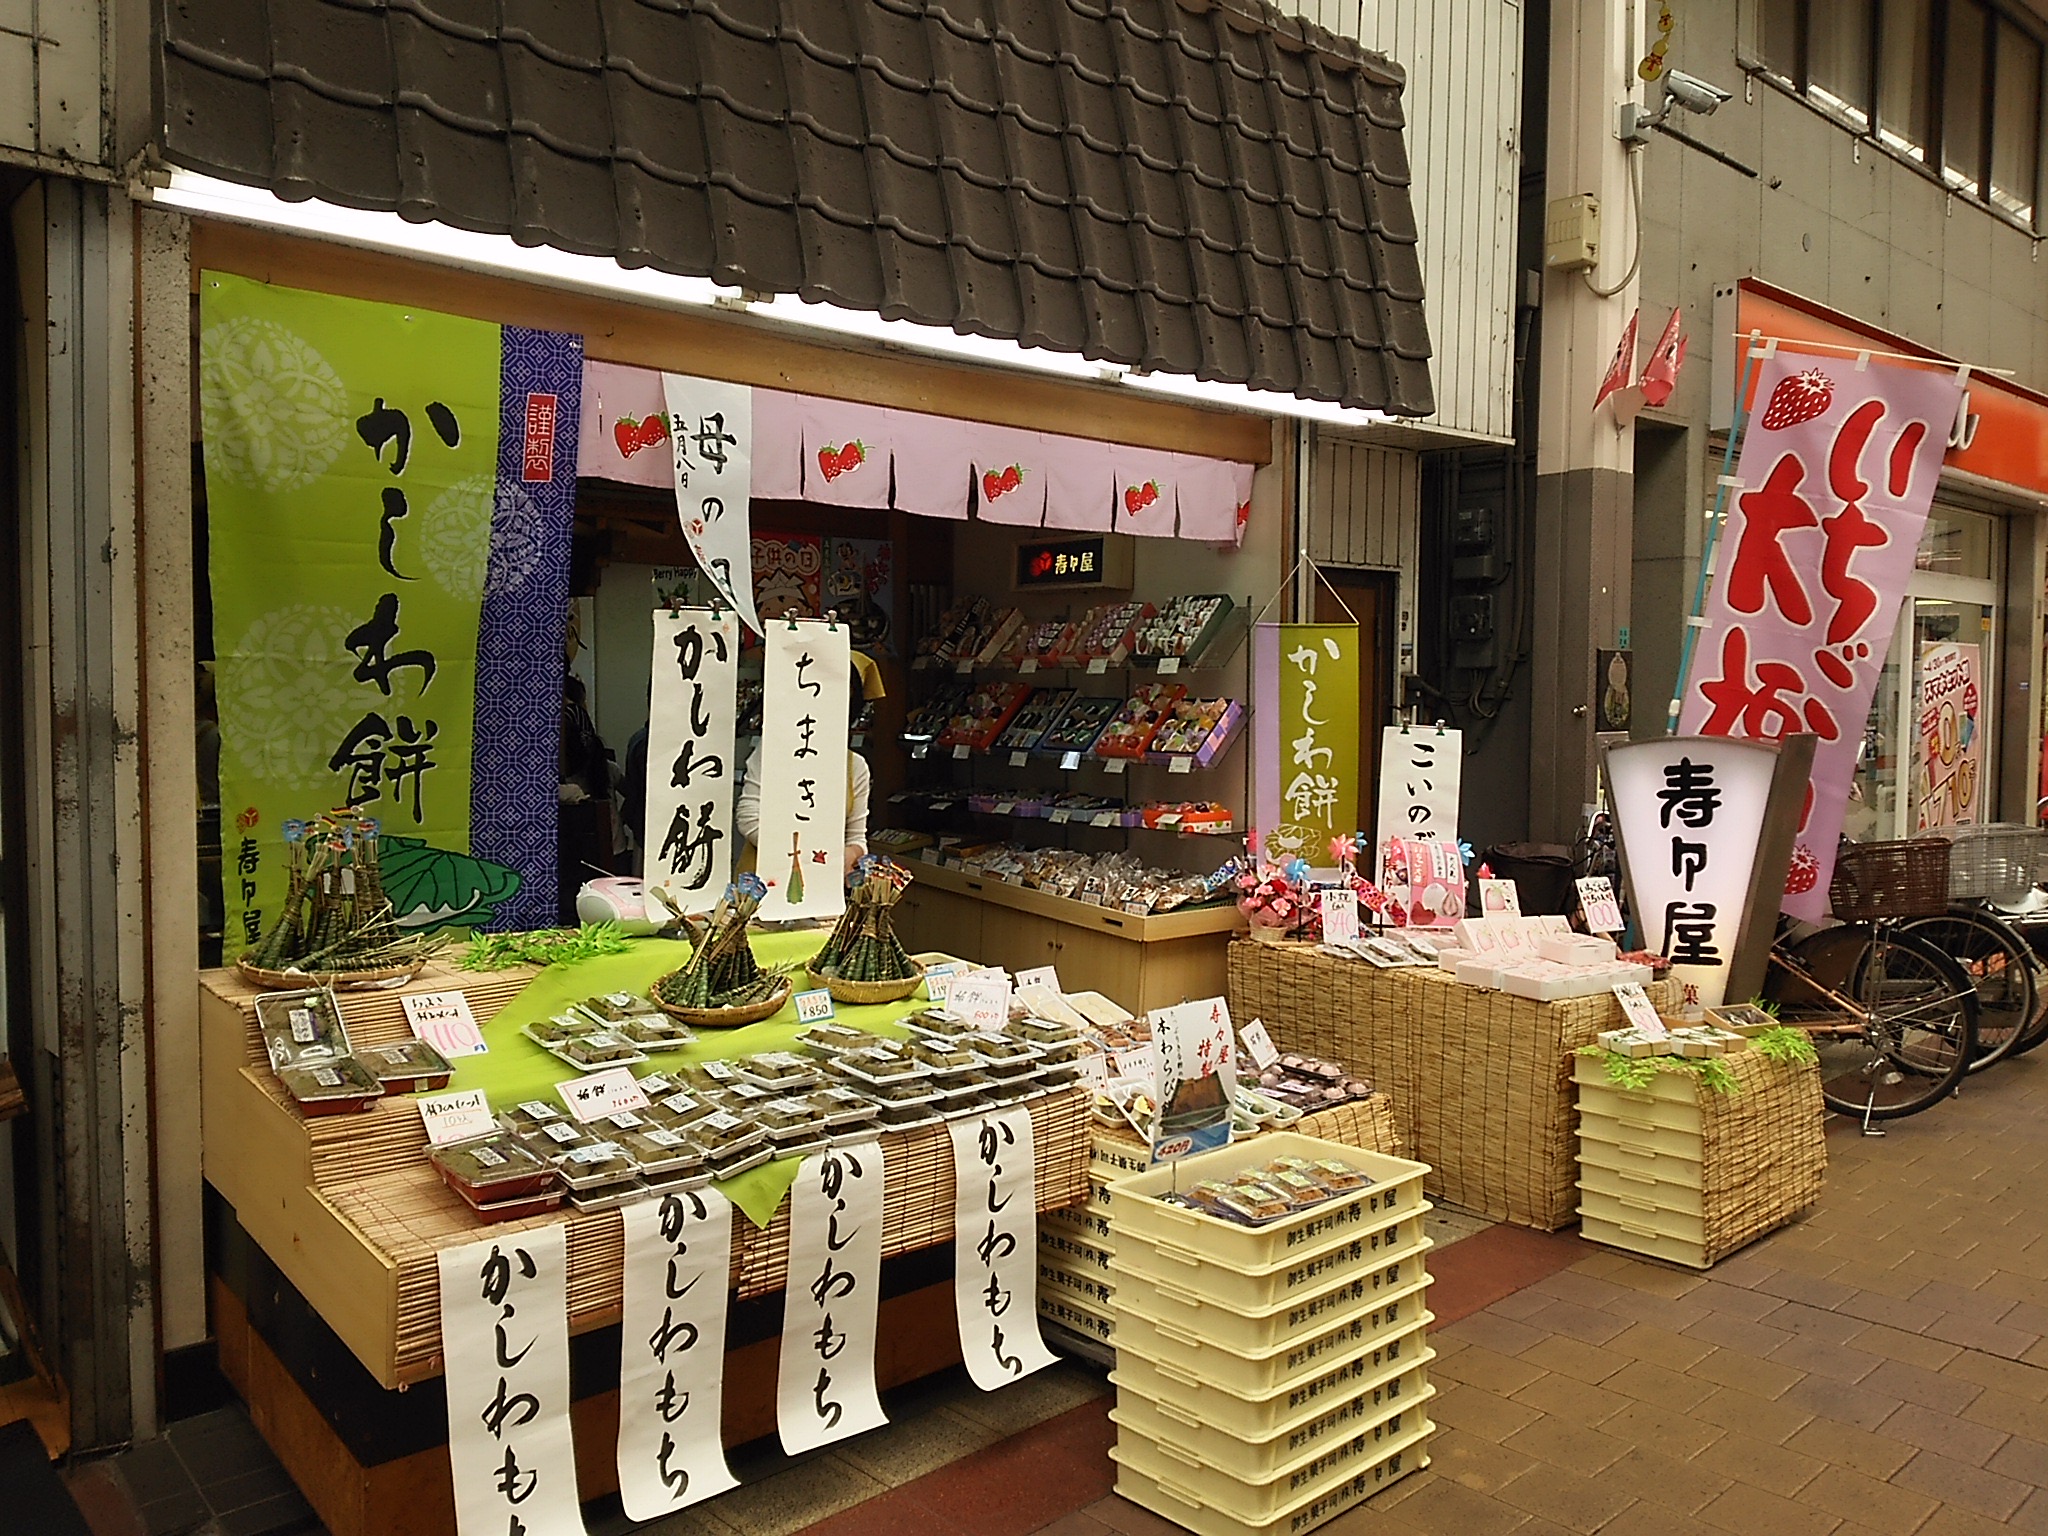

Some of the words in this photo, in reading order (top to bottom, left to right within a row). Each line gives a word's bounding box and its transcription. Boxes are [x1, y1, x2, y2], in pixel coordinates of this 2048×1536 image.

[673, 414, 696, 488] 五月八日
[328, 397, 461, 825] かしわ餅
[654, 568, 673, 580] Berry
[675, 565, 698, 580] Happy
[752, 551, 815, 570] 子供の日
[1055, 552, 1094, 575] 寿々屋
[657, 624, 729, 890] かしわ餅
[793, 652, 821, 821] ちまき
[1285, 638, 1340, 829] かしわ餅
[1326, 912, 1356, 935] 540
[1657, 757, 1723, 966] 寿々屋
[803, 1004, 828, 1017] ¥850
[1209, 1003, 1229, 1064] 寿々屋
[809, 1148, 863, 1431] かしわもち
[978, 1118, 1023, 1375] かしわもち
[649, 1191, 706, 1502] かしわもち
